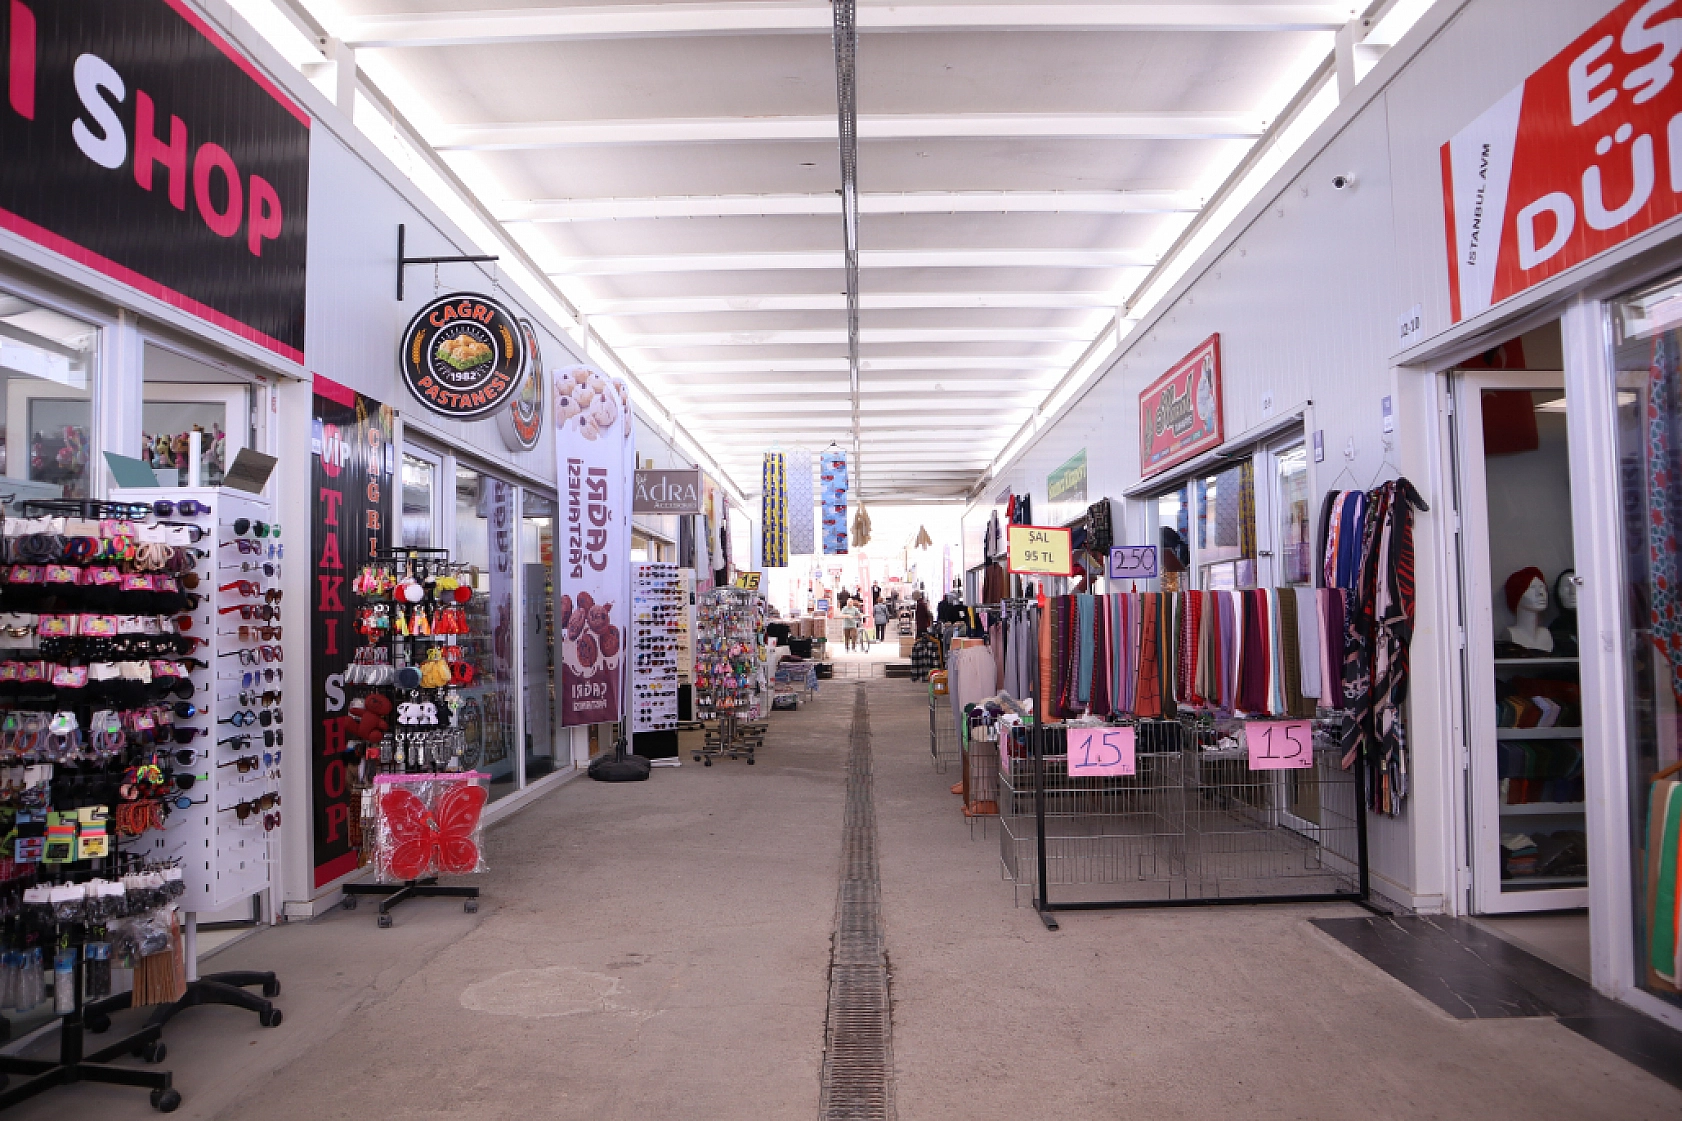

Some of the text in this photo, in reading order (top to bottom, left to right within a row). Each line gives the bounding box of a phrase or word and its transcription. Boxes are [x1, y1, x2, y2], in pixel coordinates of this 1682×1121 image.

[72, 53, 284, 258] SHOP
[1479, 143, 1491, 180] AVM
[418, 371, 511, 408] PASTANESİ
[450, 371, 477, 382] 1982
[1029, 530, 1049, 544] ŞAL
[1024, 550, 1055, 563] 95 TL
[742, 573, 759, 588] 15
[318, 487, 352, 845] TAKI SHOP
